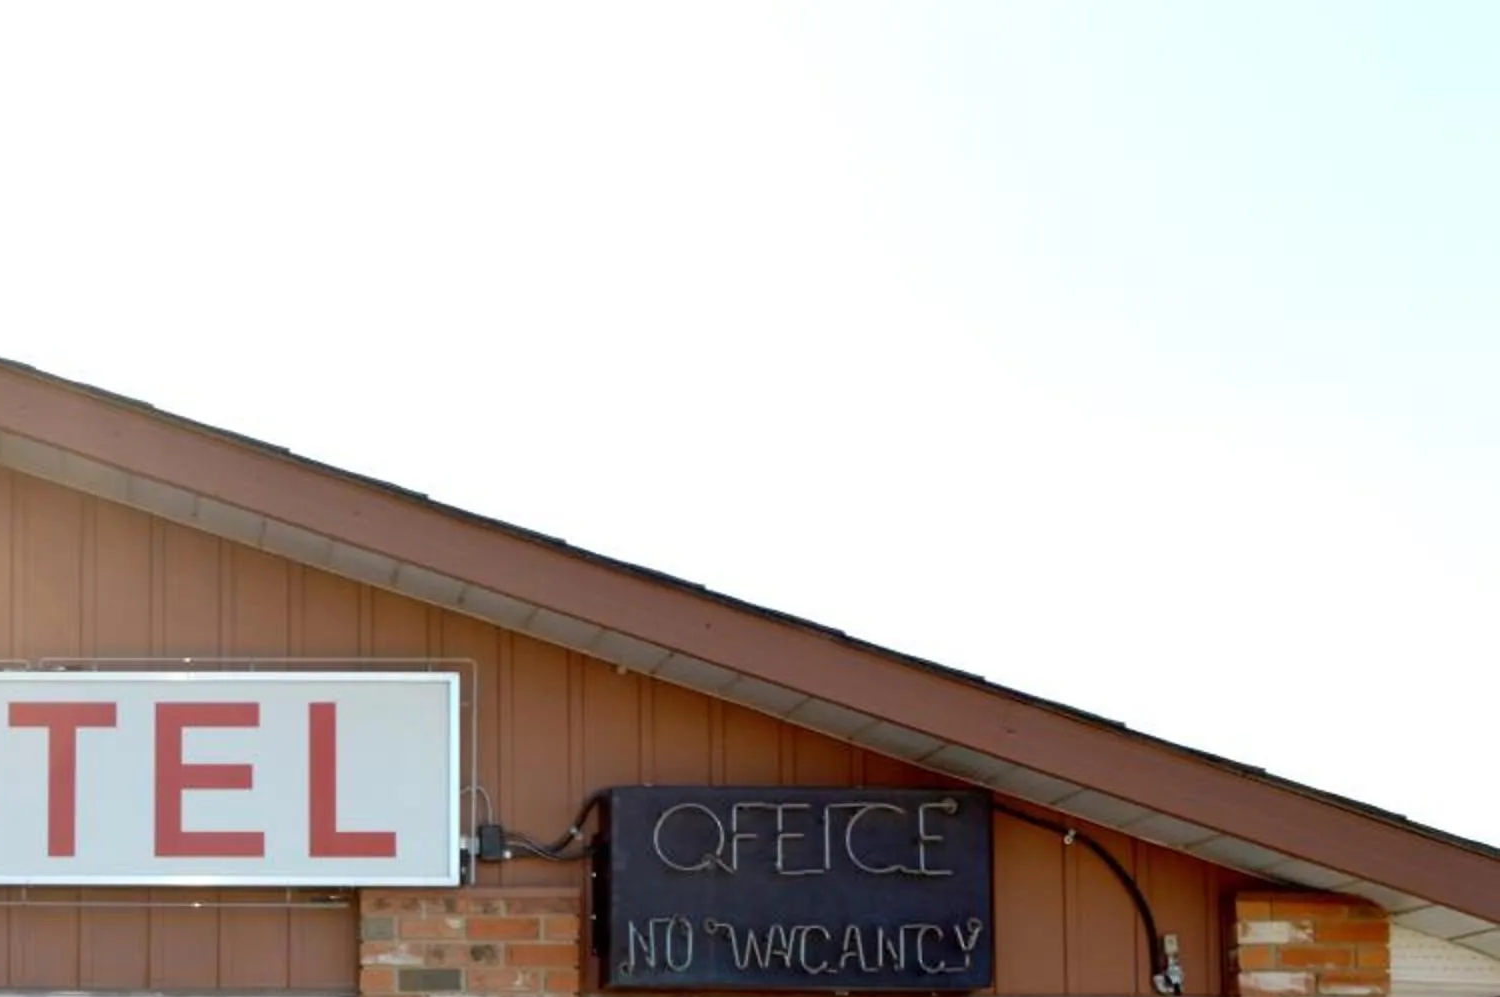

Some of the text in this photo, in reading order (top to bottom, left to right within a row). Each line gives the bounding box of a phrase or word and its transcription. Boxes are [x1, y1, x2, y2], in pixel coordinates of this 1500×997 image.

[653, 803, 956, 876] OFFICE
[627, 917, 983, 973] NO VACANCY
